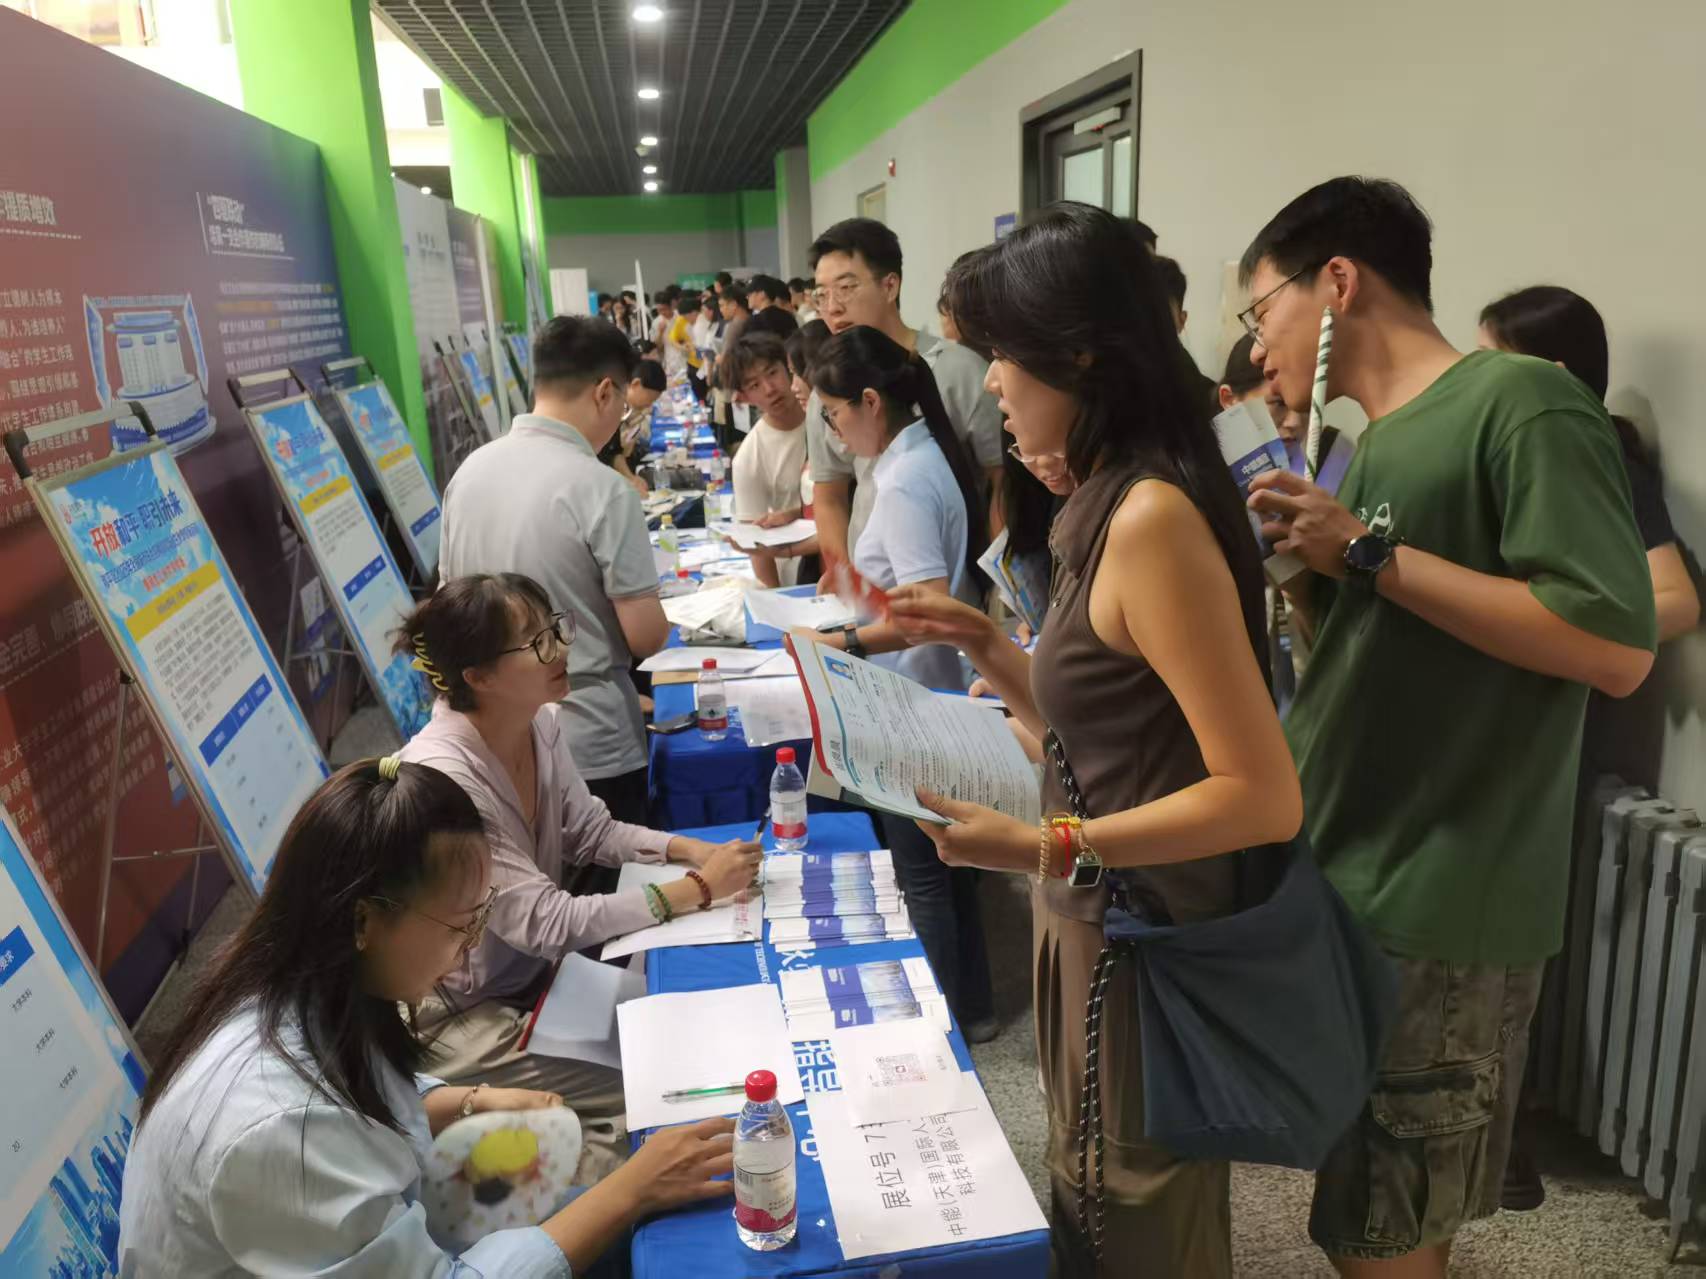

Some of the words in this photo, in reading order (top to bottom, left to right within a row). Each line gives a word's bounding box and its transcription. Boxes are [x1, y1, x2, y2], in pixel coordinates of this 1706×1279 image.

[869, 1151, 913, 1209] 展位号
[929, 1114, 976, 1195] 科技有限公司
